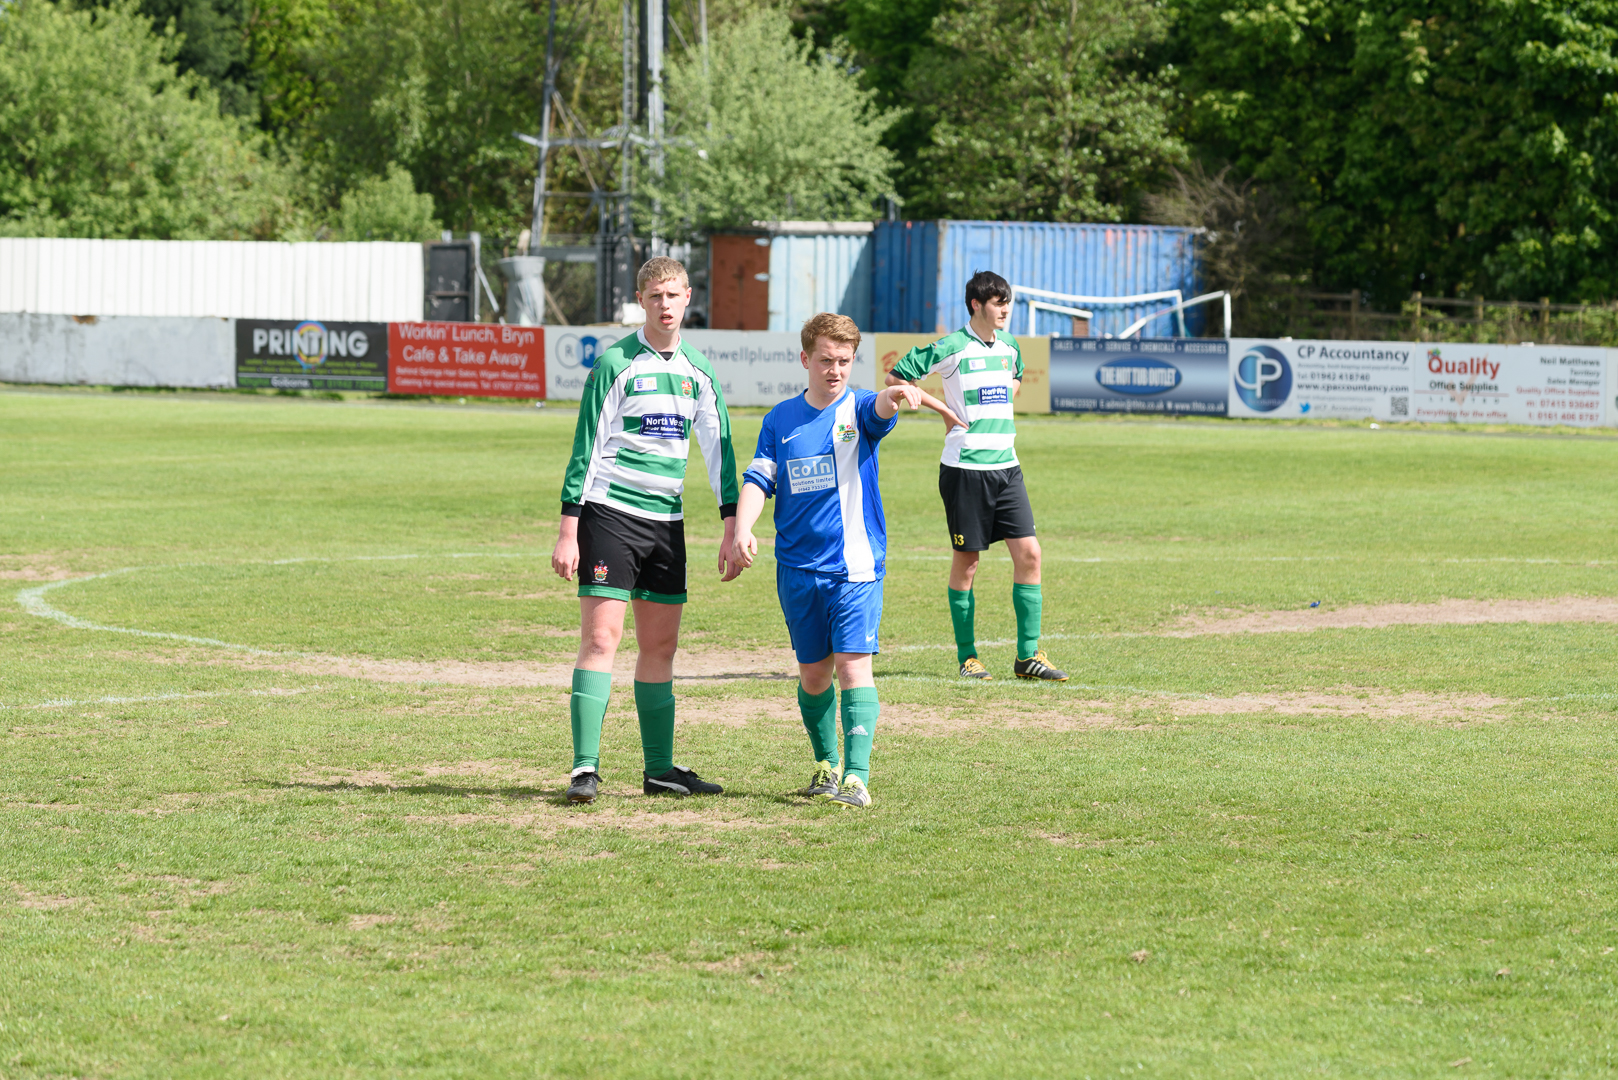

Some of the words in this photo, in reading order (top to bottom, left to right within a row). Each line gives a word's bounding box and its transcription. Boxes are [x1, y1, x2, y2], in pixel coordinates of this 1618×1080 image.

[253, 329, 368, 357] PRINTING
[398, 324, 450, 340] Workin'
[452, 326, 498, 344] Lunch,
[501, 327, 535, 347] Bryn
[584, 344, 594, 360] P
[1053, 340, 1073, 351] SALES
[1105, 341, 1131, 352] SERVICE
[1139, 342, 1175, 353] CHEMICALS
[1184, 343, 1227, 354] ACCESSORIES
[1297, 345, 1315, 359] CP
[1320, 346, 1410, 364] Accountancy
[402, 345, 436, 363] Cafe
[438, 346, 449, 363] &
[452, 346, 486, 365] Take
[488, 349, 528, 370] Away
[1428, 356, 1501, 380] Quality
[756, 382, 774, 394] Tel:
[1429, 380, 1456, 390] Office
[1459, 380, 1499, 394] Supplies
[1516, 385, 1542, 396] Quality
[791, 460, 831, 477] coin
